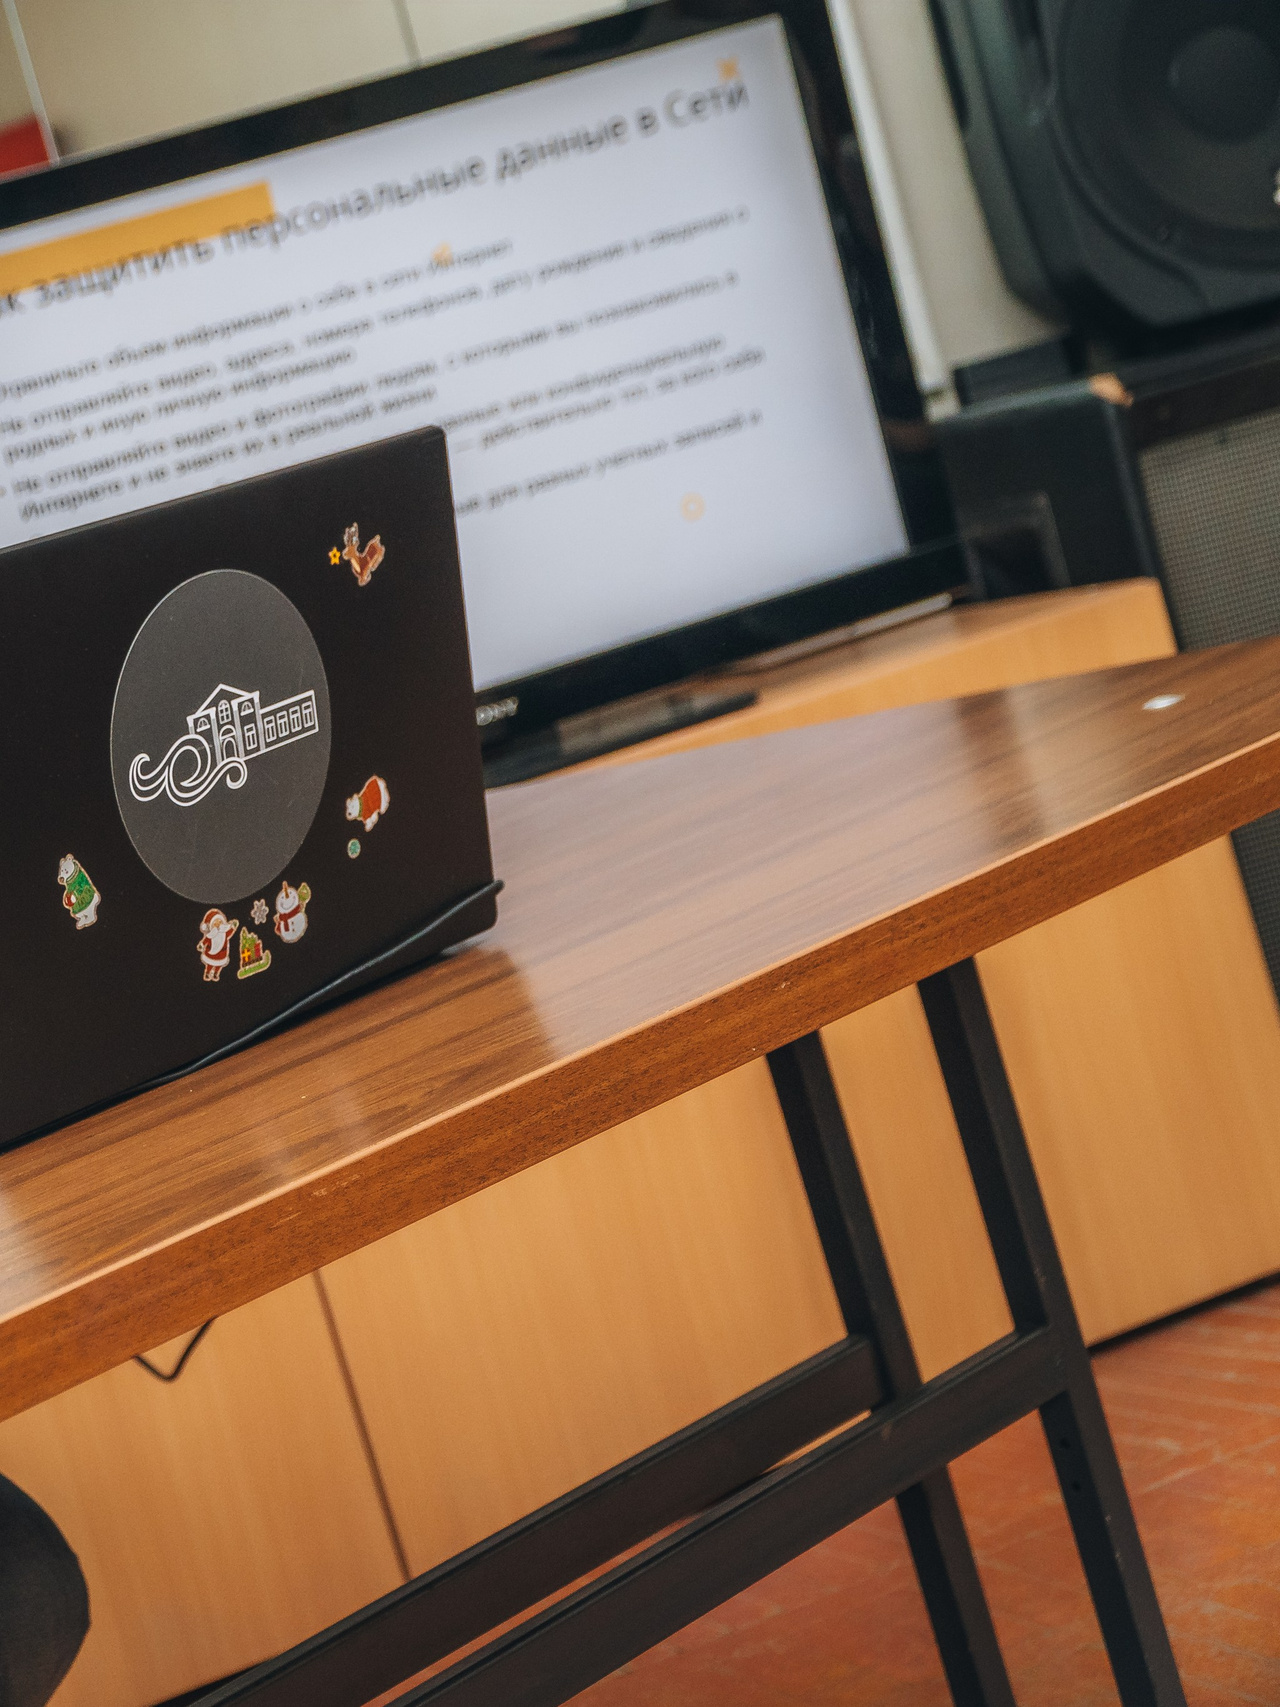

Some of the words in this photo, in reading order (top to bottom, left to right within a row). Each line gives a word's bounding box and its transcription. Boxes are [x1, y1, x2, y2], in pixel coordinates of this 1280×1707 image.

[33, 239, 213, 307] защитить
[220, 157, 484, 252] персональные
[496, 116, 626, 181] данные
[636, 108, 657, 136] в
[665, 81, 747, 125] Сети
